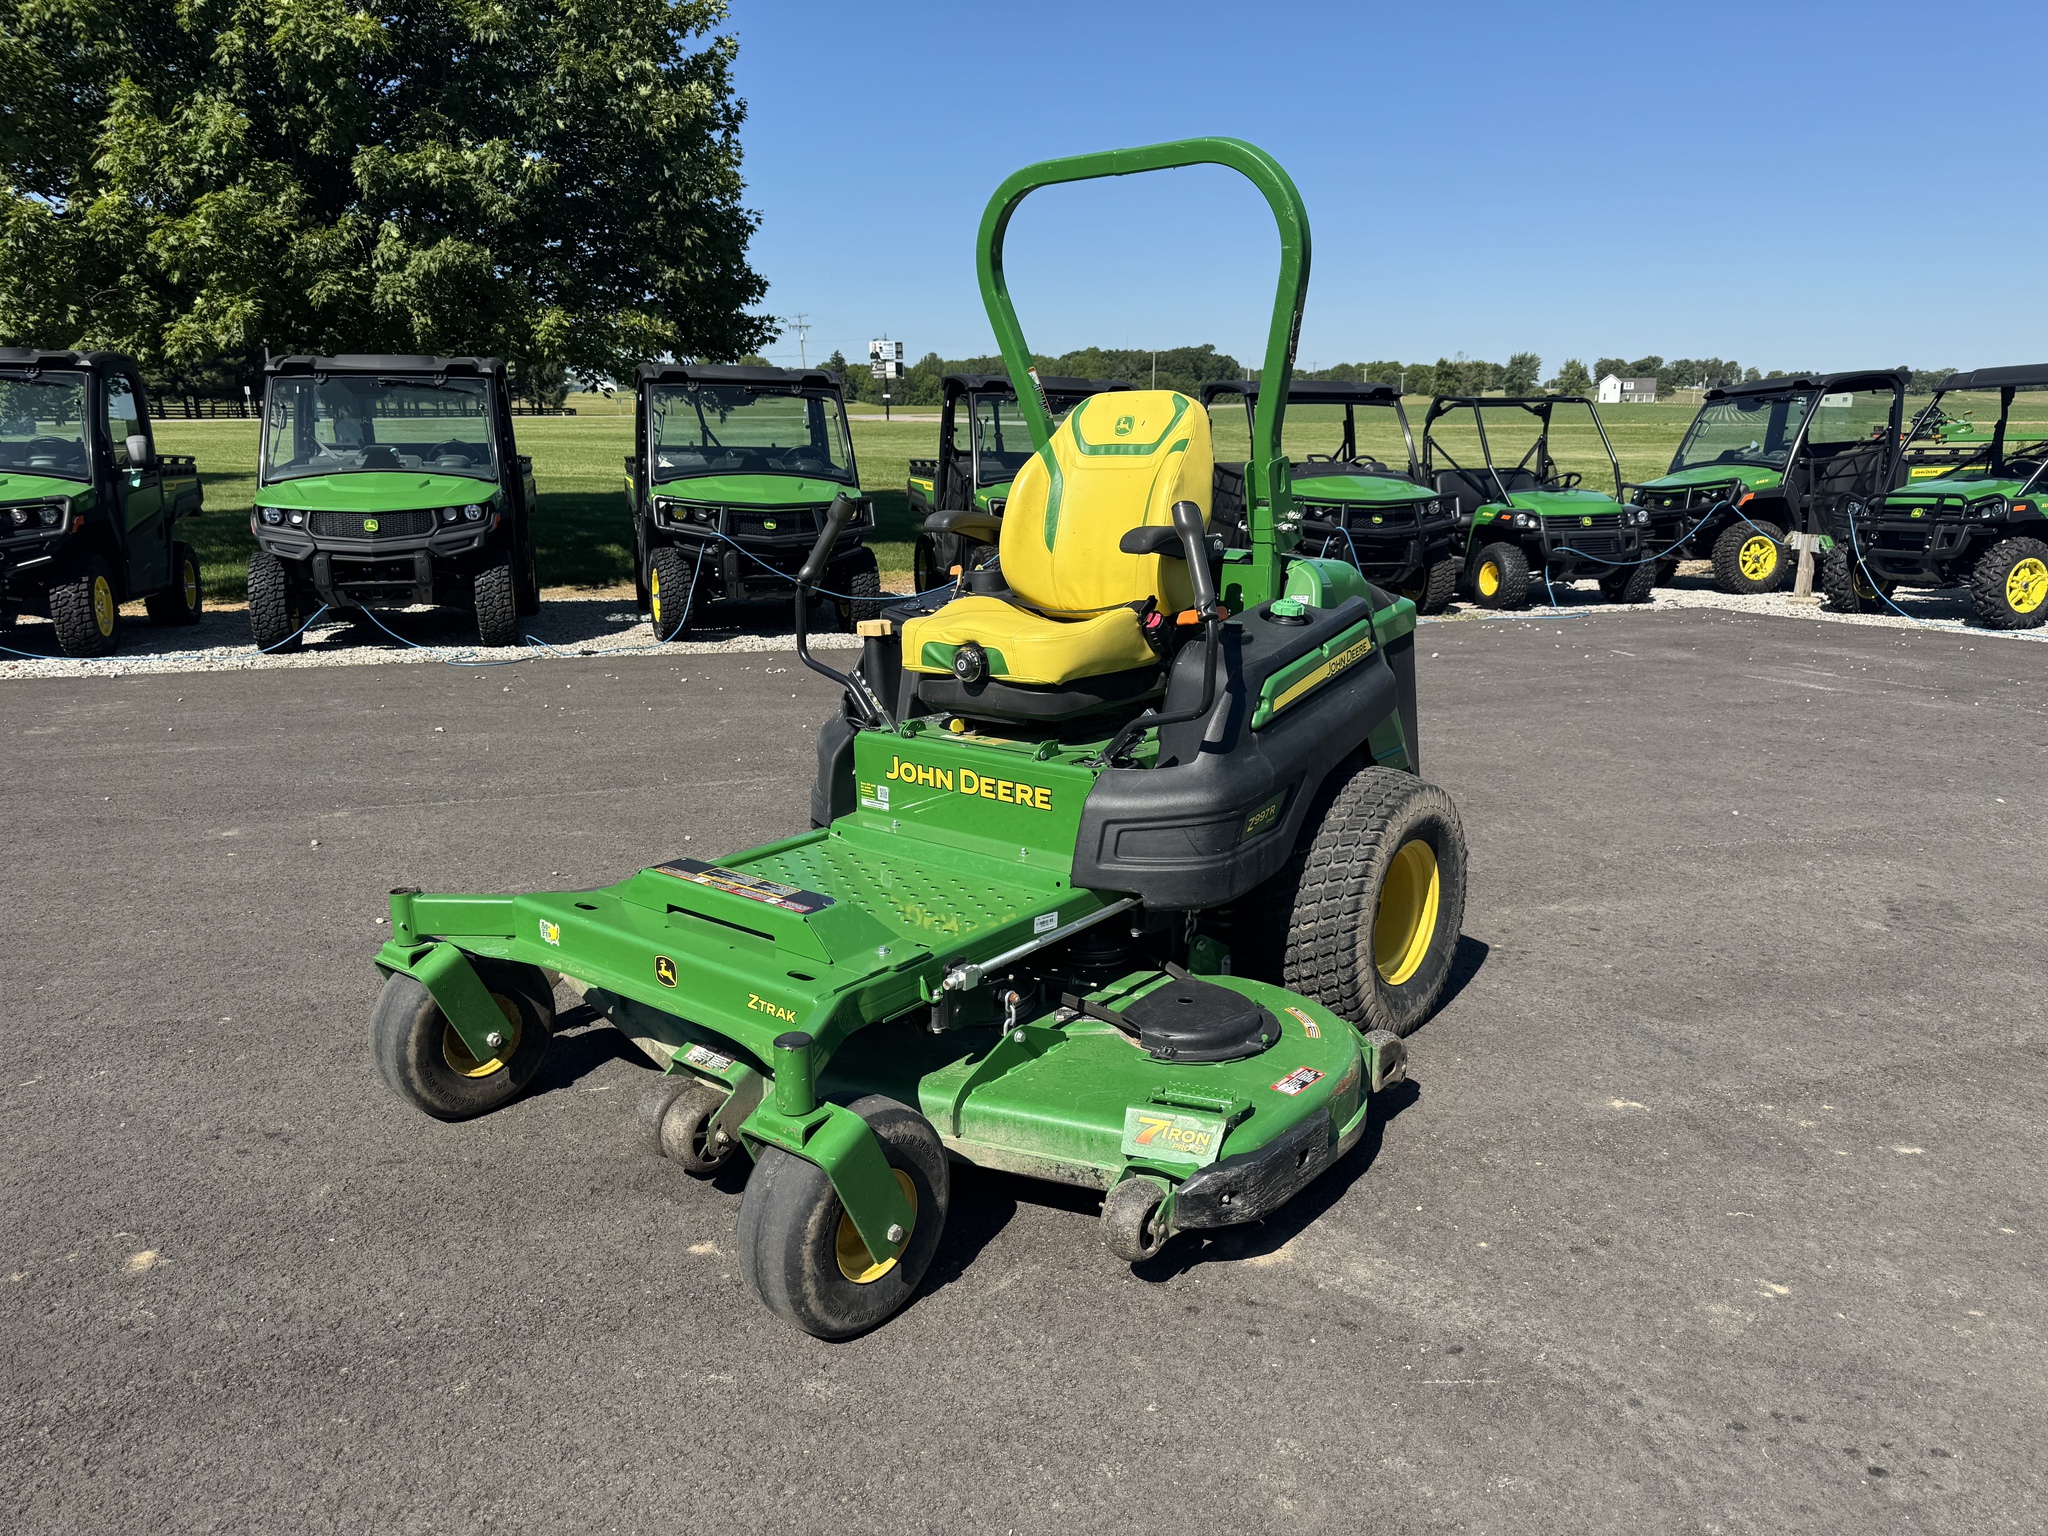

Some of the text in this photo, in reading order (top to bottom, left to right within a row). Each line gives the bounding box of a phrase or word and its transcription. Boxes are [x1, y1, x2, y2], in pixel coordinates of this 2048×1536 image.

[1326, 641, 1368, 677] JOHN DEERE
[885, 755, 953, 791] JOHN
[959, 767, 1053, 812] DEERE
[1246, 804, 1276, 833] Z997R
[747, 993, 798, 1025] ZTRAK
[889, 1132, 939, 1164] LIANCE
[1172, 1143, 1190, 1152] PRO
